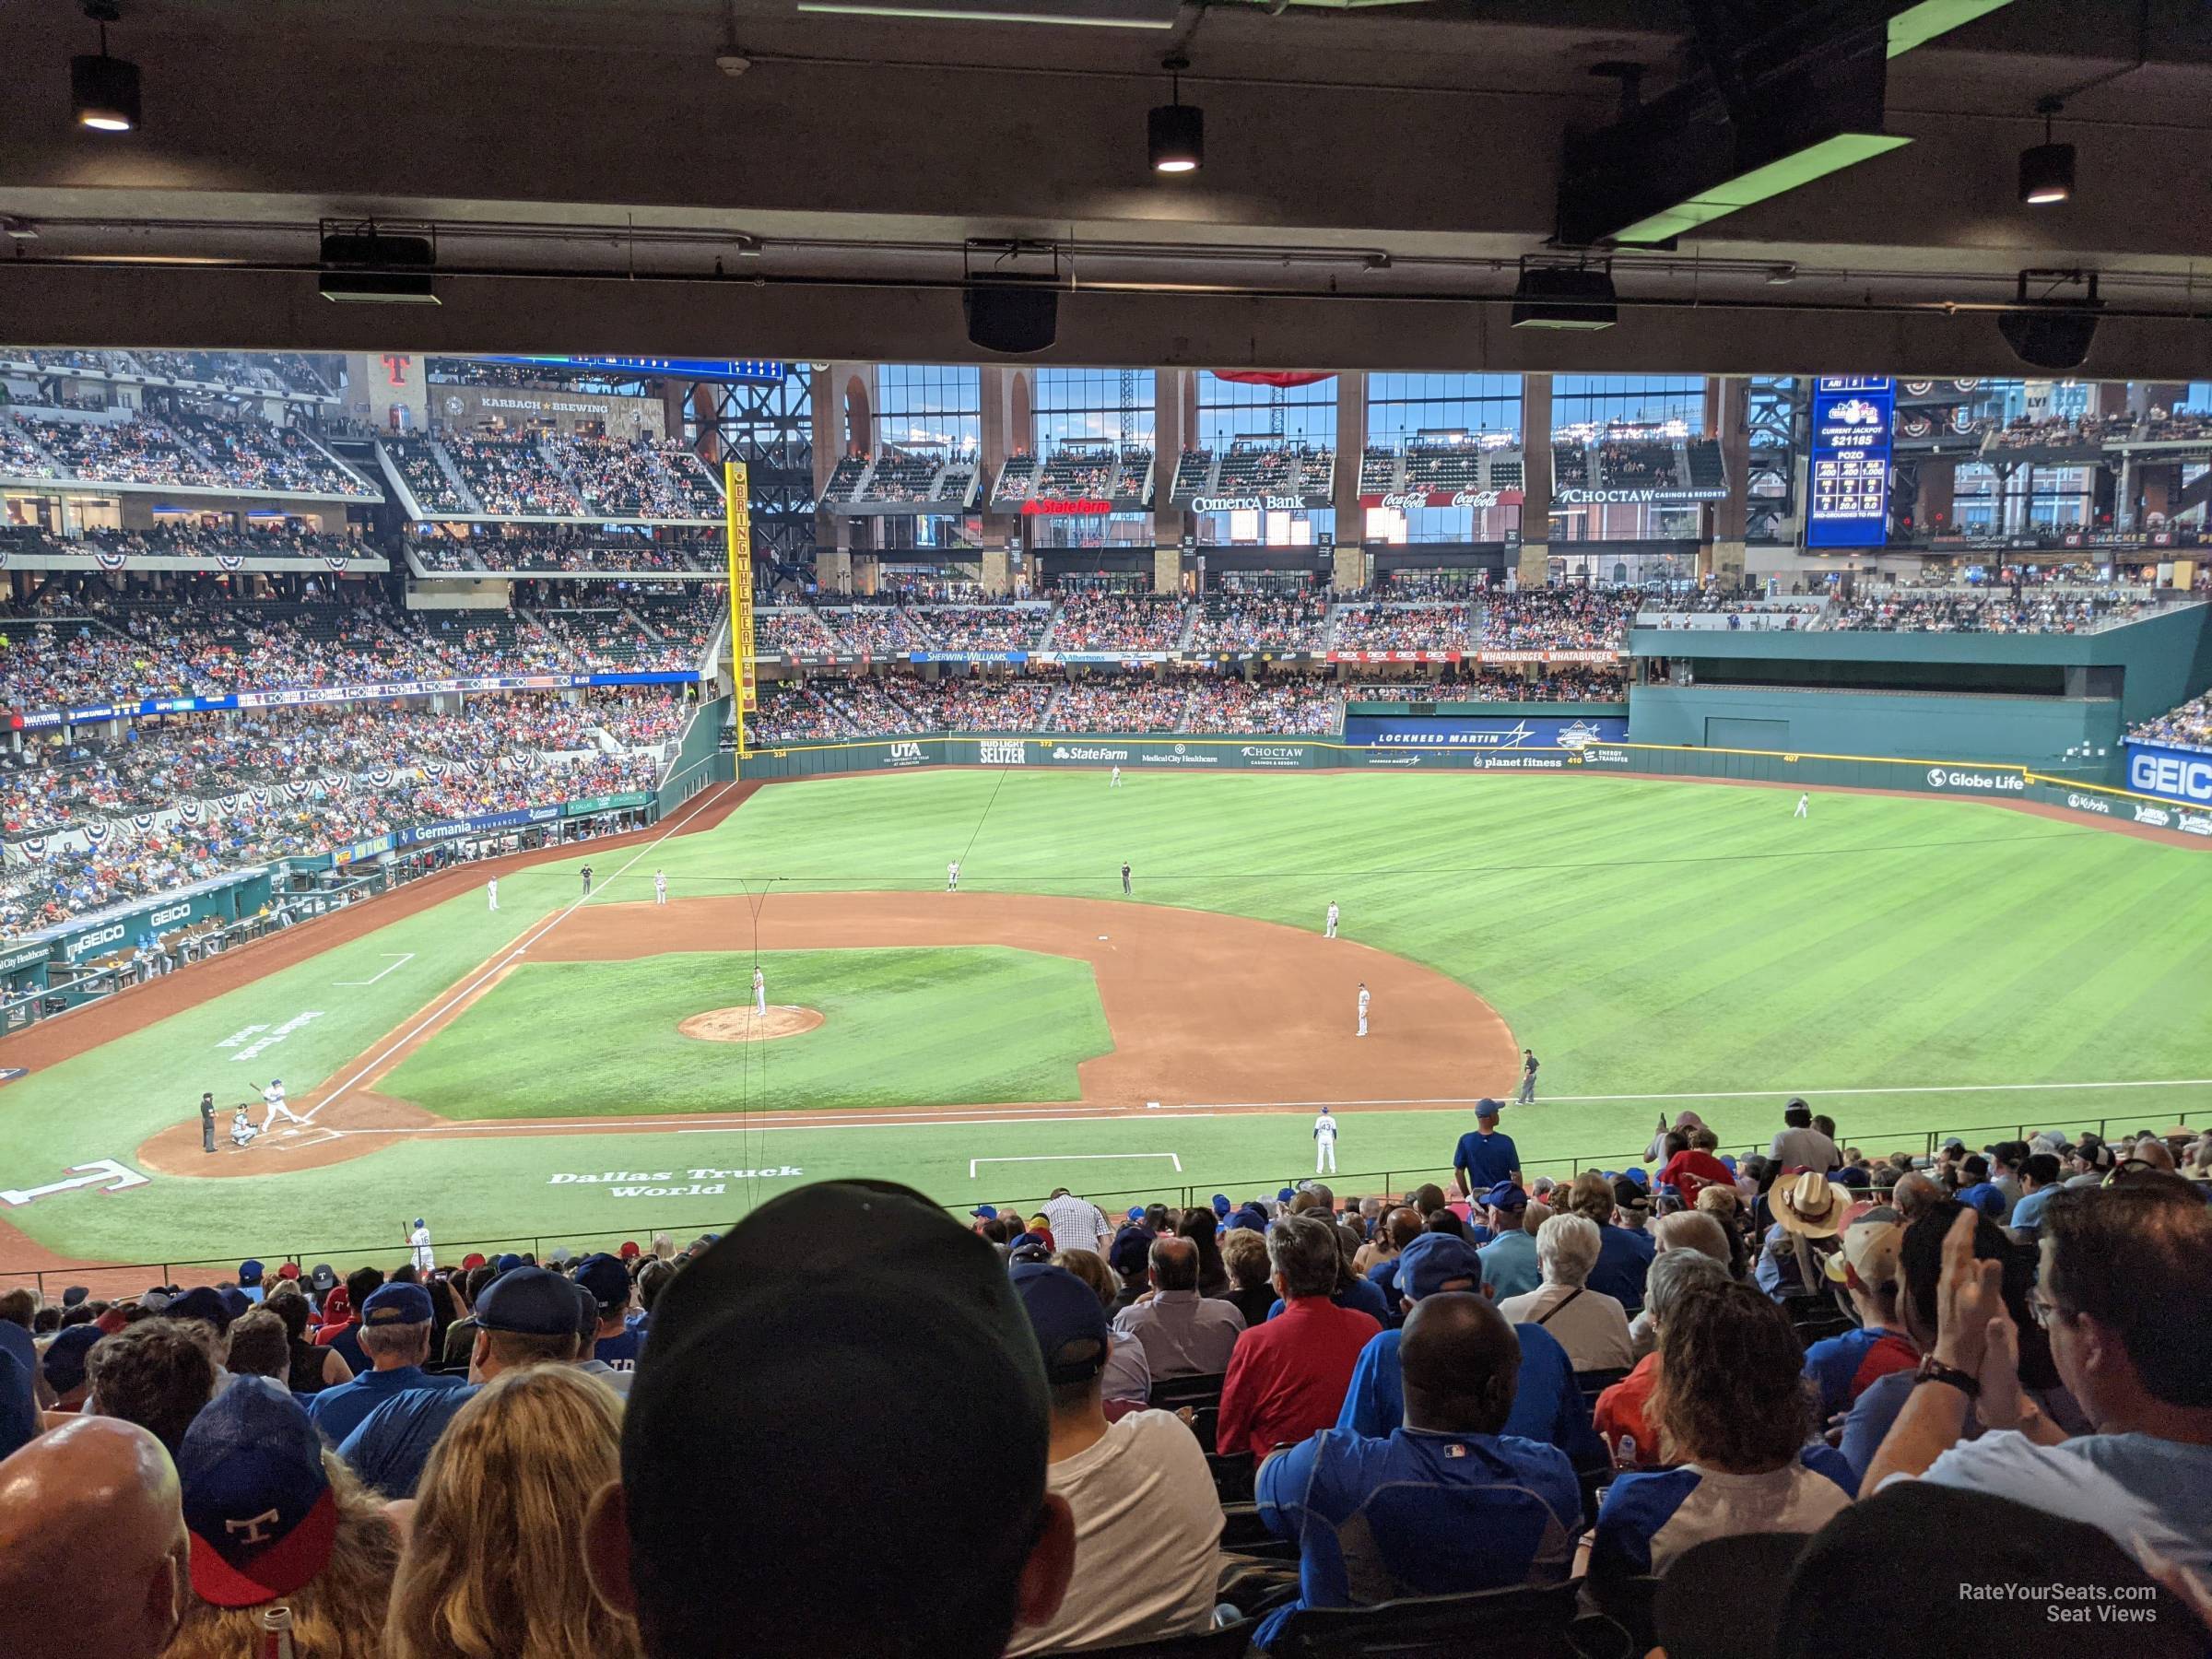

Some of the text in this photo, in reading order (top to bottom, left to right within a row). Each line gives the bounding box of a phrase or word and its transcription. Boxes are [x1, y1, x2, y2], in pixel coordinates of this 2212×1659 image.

[381, 354, 413, 386] T
[482, 397, 608, 414] KARBACH BREWING
[1830, 436, 1874, 446] $21185
[1838, 451, 1864, 460] POZO
[1569, 489, 1655, 502] CHOCTAW
[1867, 485, 1875, 493] 0
[1265, 495, 1306, 509] Bank
[1382, 492, 1430, 509] Coca-Cola
[1452, 490, 1500, 508] Coca-Cola
[1481, 652, 1544, 662] WHATABURGER
[1549, 652, 1613, 662] WHATABURGER
[157, 702, 172, 711] MPH
[24, 712, 61, 724] BALCONES
[1379, 735, 1444, 743] LOCKHEED
[891, 743, 921, 758] UTA
[980, 747, 1025, 763] SELTZER
[1246, 747, 1303, 757] CHOCTAW
[1142, 755, 1218, 764] Medical City Healthcare
[1485, 757, 1562, 769] planet fitness
[1948, 772, 2024, 790] Globe Life
[2132, 754, 2212, 799] GEIC
[2080, 796, 2110, 813] Kubota
[416, 821, 472, 840] Germania
[473, 818, 517, 830] INSURANCE
[151, 903, 191, 927] GEICO
[80, 924, 124, 949] GEICO
[4, 957, 17, 968] City
[17, 948, 49, 964] Healthcare
[547, 1166, 804, 1184] Dallas Truck
[608, 1184, 726, 1197] World
[421, 1236, 429, 1245] 16
[335, 1300, 344, 1311] T
[225, 1508, 279, 1545] T
